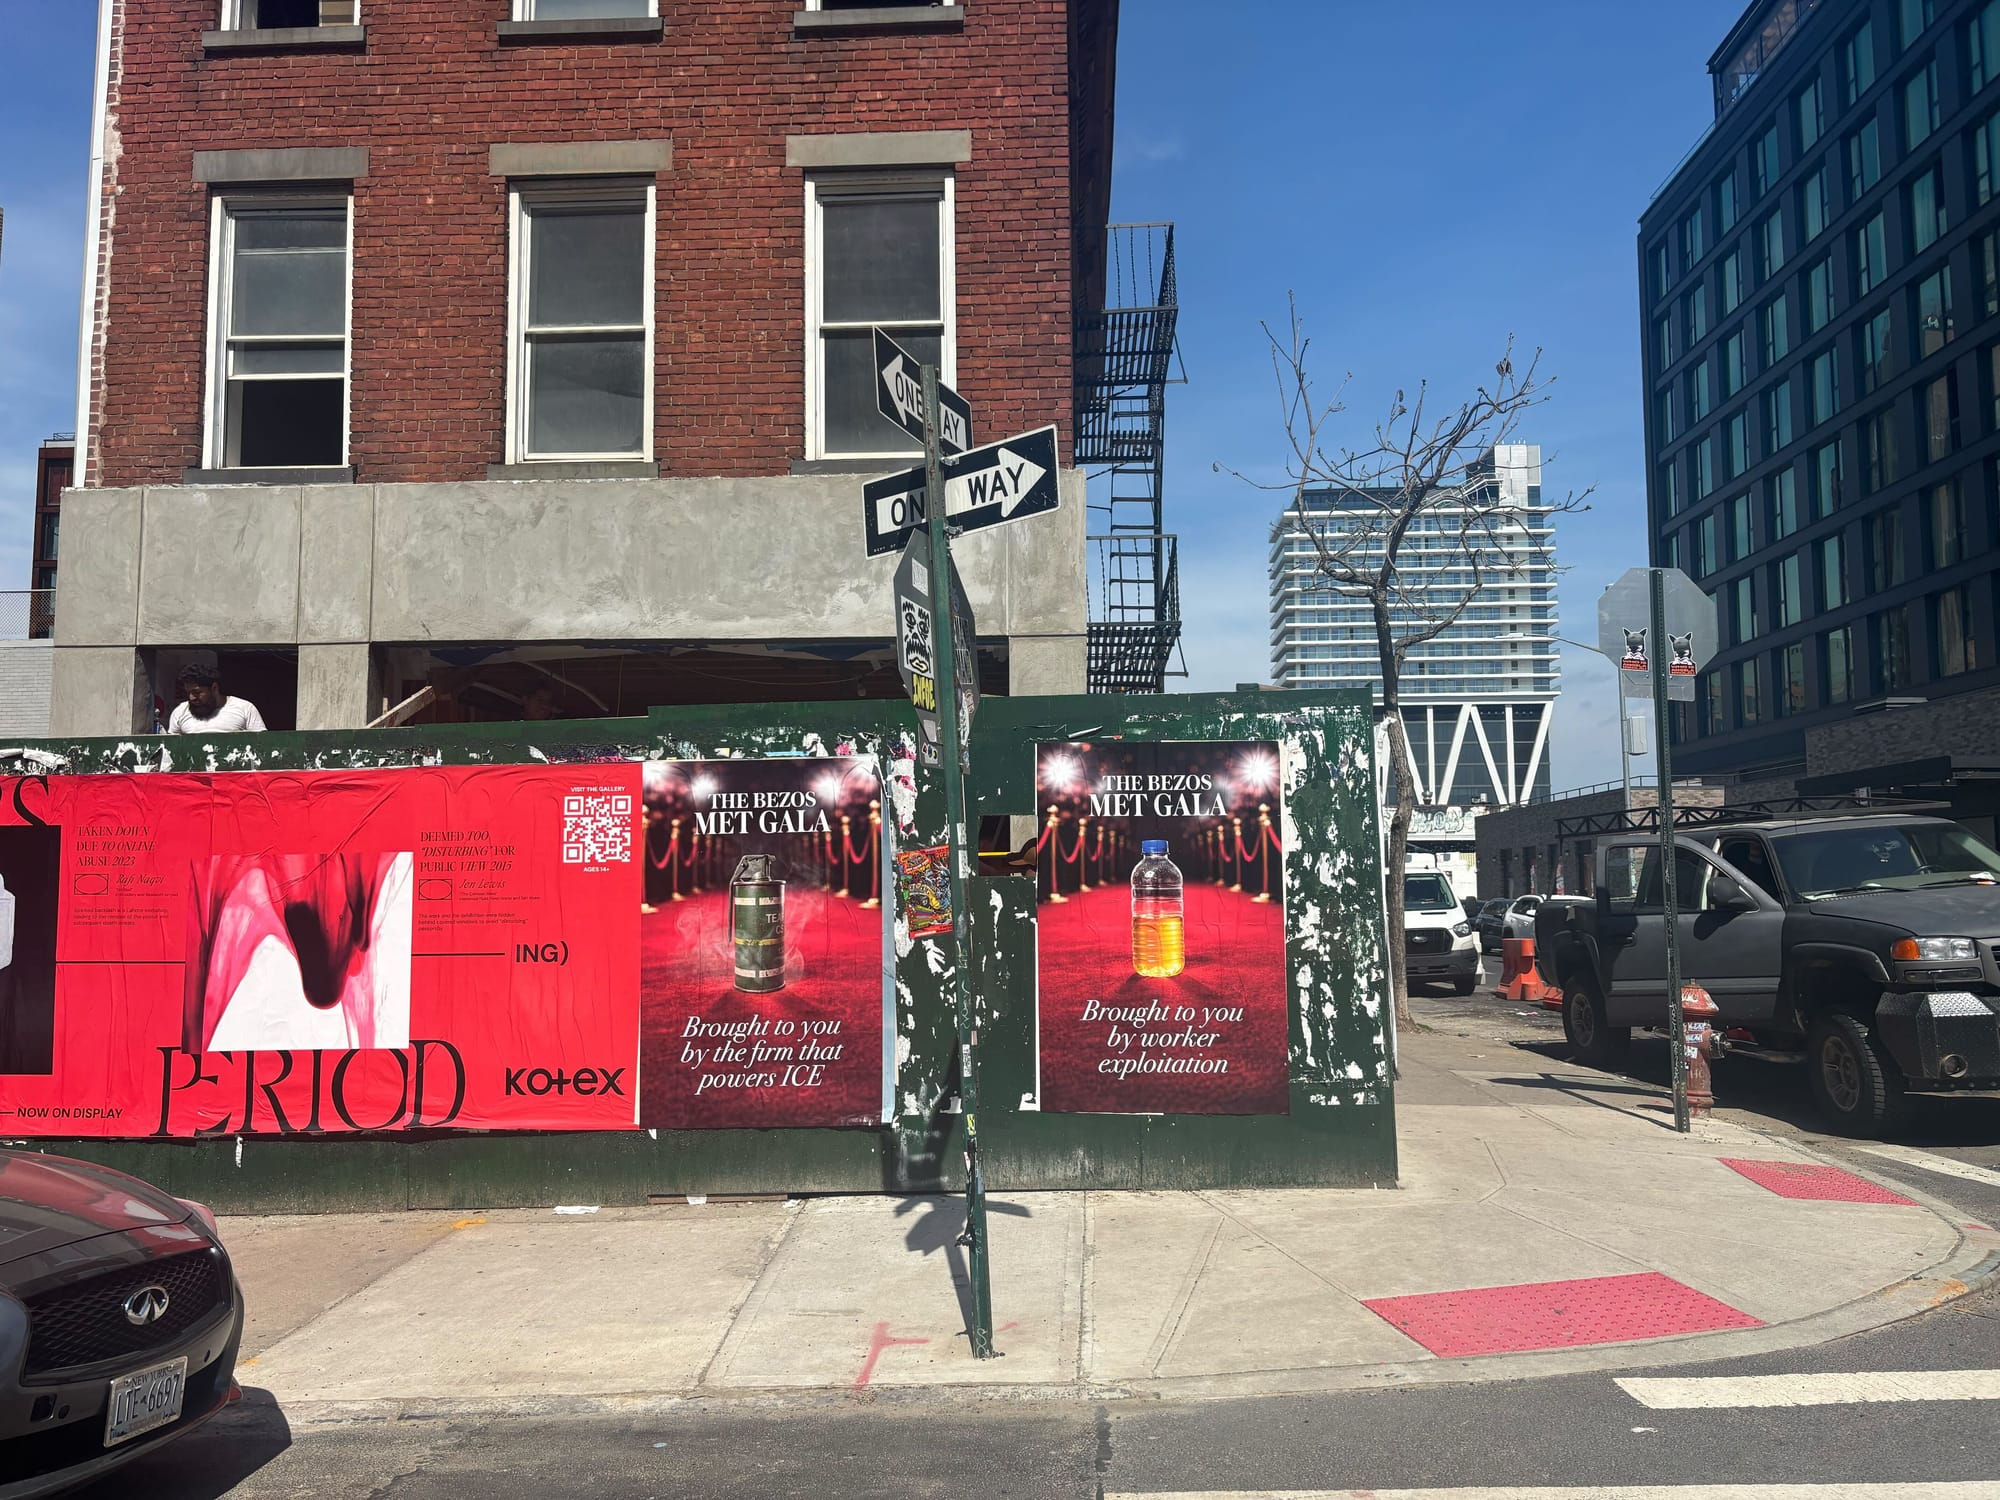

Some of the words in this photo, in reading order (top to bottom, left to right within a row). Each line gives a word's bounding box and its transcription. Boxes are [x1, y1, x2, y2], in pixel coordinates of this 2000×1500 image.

[891, 491, 926, 527] ON
[968, 463, 1025, 506] WAY
[1102, 775, 1143, 791] THE
[1147, 774, 1212, 791] BEZOS
[708, 792, 749, 809] THE
[753, 791, 817, 808] BEZOS
[1088, 793, 1148, 817] MET
[1153, 792, 1228, 817] GALA
[78, 826, 113, 837] TAKEN
[115, 826, 149, 836] DOWN
[694, 811, 754, 836] MET
[759, 809, 832, 834] GALA
[76, 841, 98, 851] DUE
[101, 841, 116, 851] TO
[117, 841, 155, 851] ONLINE
[420, 831, 465, 842] DEEMED
[467, 830, 490, 841] TOO
[78, 856, 109, 866] ABUSE
[112, 855, 136, 866] 2023
[494, 845, 516, 856] FOR
[419, 861, 456, 872] PUBLIC
[459, 861, 489, 871] VIEW
[489, 860, 513, 871] 2015
[515, 940, 569, 966] ING)
[1080, 999, 1171, 1029] Brought
[1174, 1005, 1196, 1021] to
[1198, 1007, 1243, 1028] you
[680, 1014, 771, 1043] Brought
[774, 1020, 795, 1036] to
[797, 1019, 841, 1042] you
[1107, 1025, 1136, 1054] by
[1140, 1025, 1220, 1047] worker
[680, 1041, 710, 1069] by
[712, 1040, 747, 1063] the
[744, 1040, 793, 1069] firm
[798, 1038, 844, 1061] that
[1098, 1051, 1228, 1081] exploitation
[150, 1039, 466, 1138] PERIOD
[694, 1072, 777, 1096] powers
[779, 1064, 826, 1087] ICE
[17, 1107, 49, 1118] NOW
[52, 1107, 70, 1118] ON
[73, 1107, 123, 1119] DISPLAY
[131, 1372, 150, 1387] NEW
[151, 1367, 168, 1380] YORK
